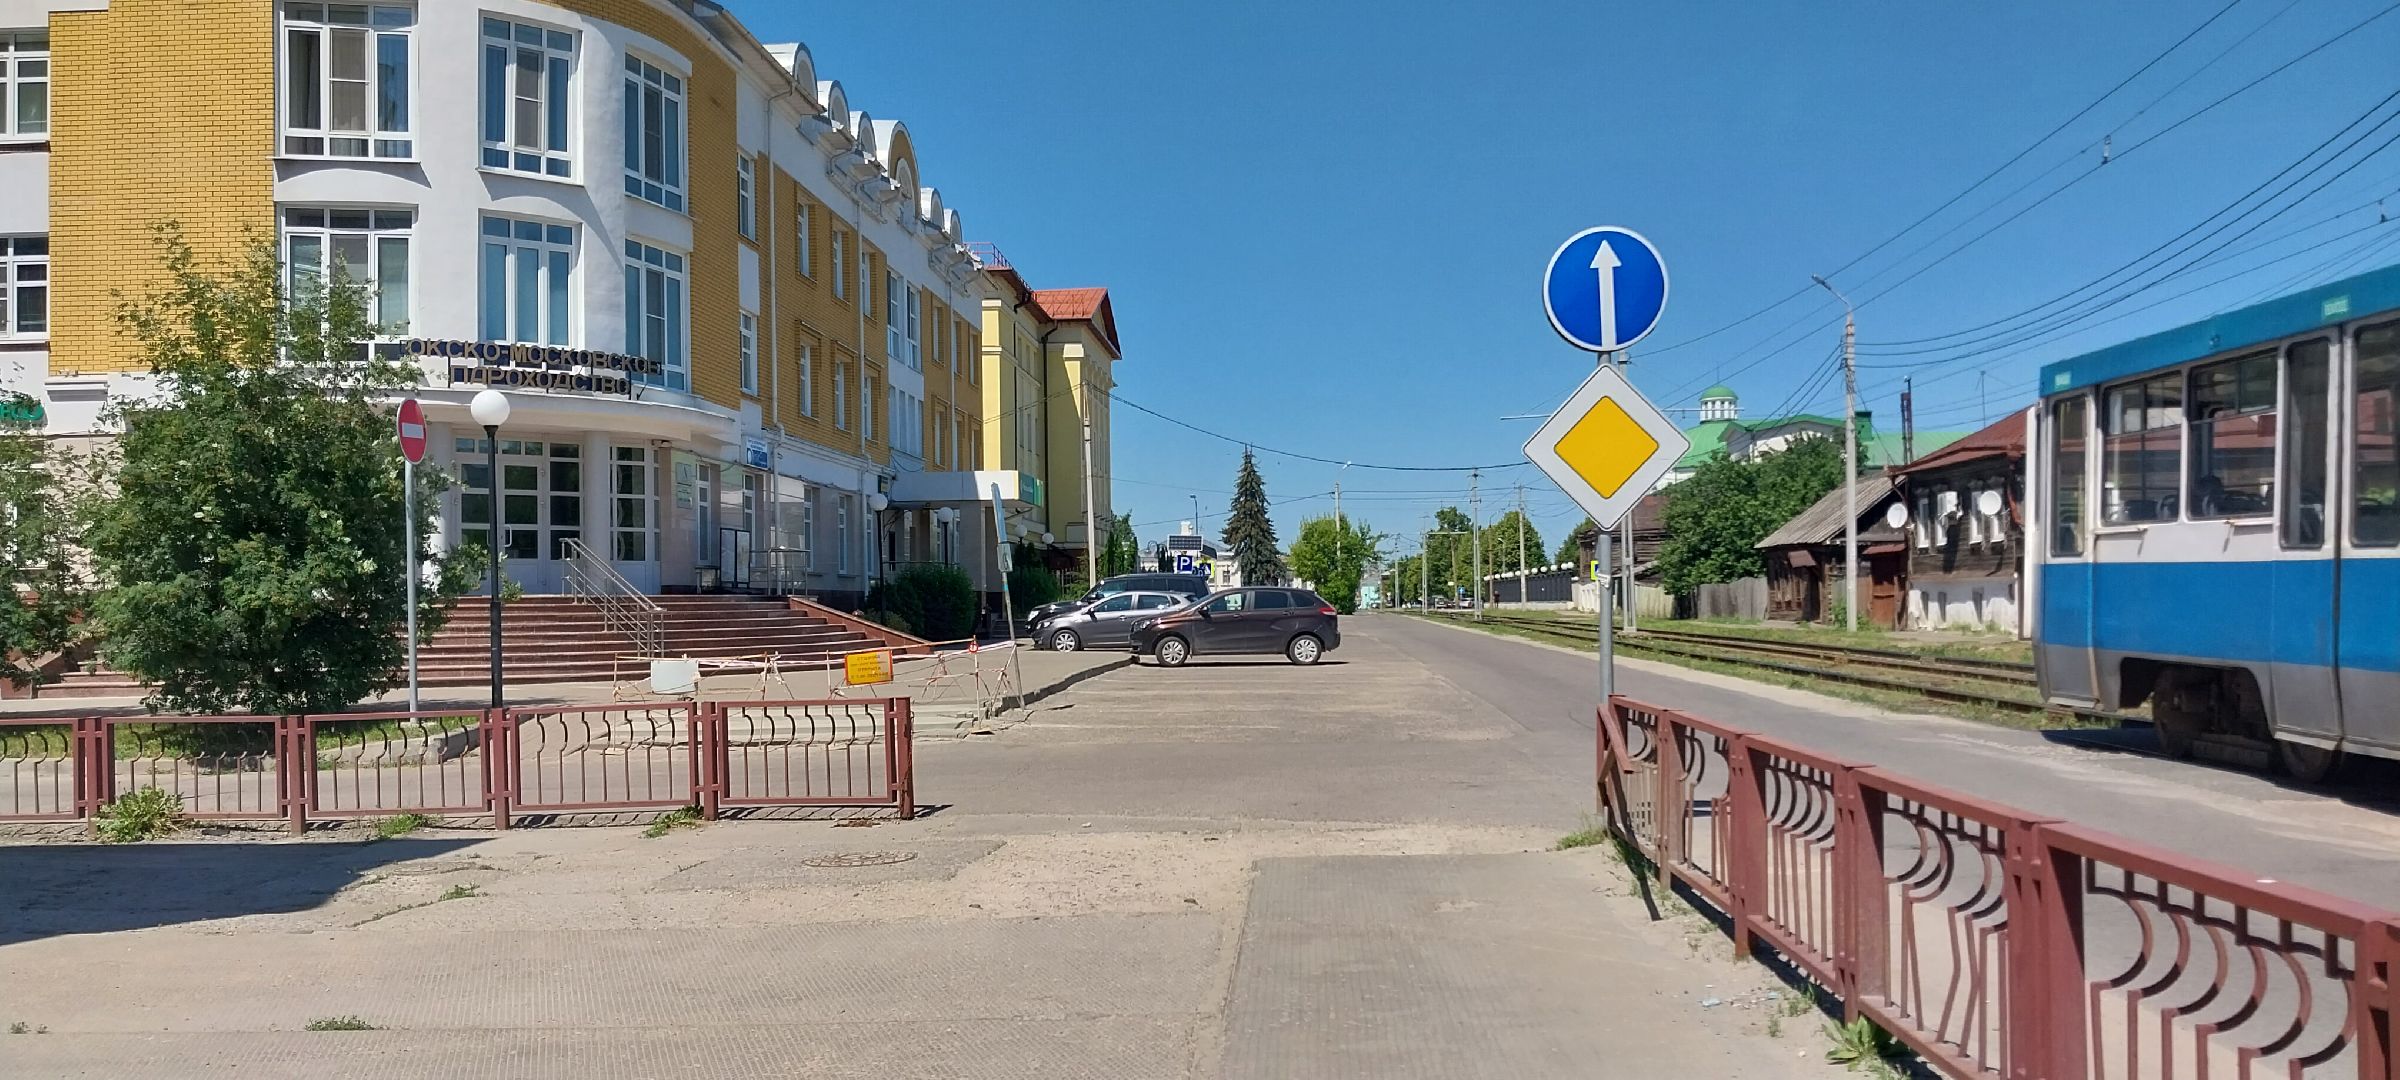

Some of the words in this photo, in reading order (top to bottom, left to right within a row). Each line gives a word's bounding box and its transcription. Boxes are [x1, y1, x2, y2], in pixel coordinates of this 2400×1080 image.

[407, 338, 661, 375] ОКСКО-МОСКОВСКОЕ
[450, 364, 630, 395] ПАРОХОДСТВО
[1181, 556, 1190, 570] P
